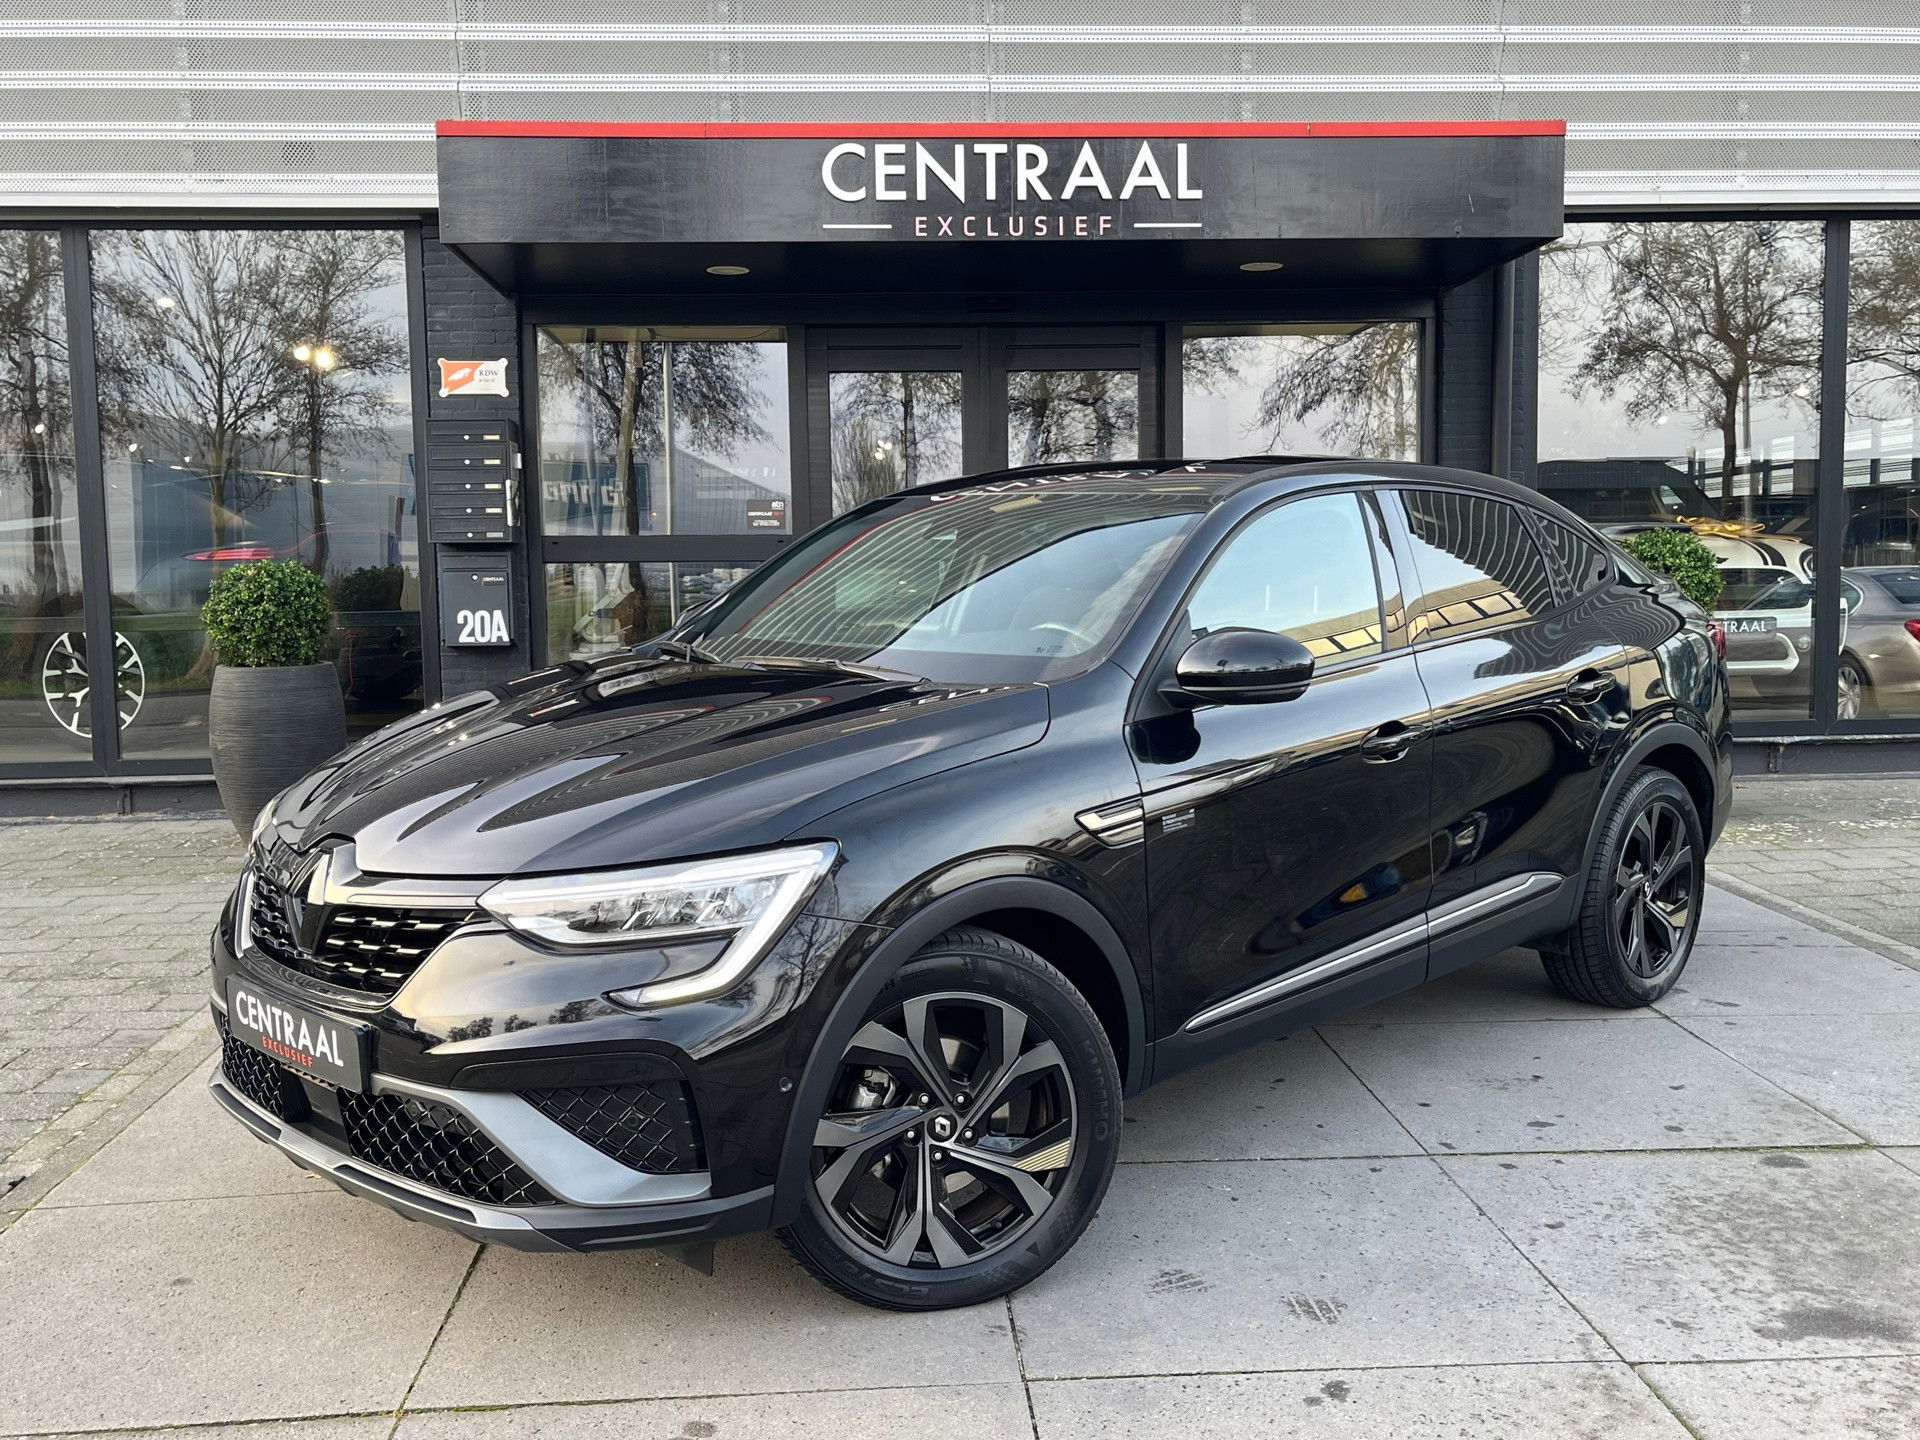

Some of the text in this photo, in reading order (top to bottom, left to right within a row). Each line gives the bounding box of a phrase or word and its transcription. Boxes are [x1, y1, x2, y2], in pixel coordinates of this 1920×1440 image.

[821, 140, 1203, 204] CENTRAAL
[914, 215, 1114, 237] EXCLUSIEF
[479, 369, 499, 377] RDW
[457, 609, 510, 643] 20A
[1722, 620, 1768, 633] TRAAL
[235, 990, 344, 1067] CENTRAAL
[262, 1036, 314, 1068] EXCLUSIEF
